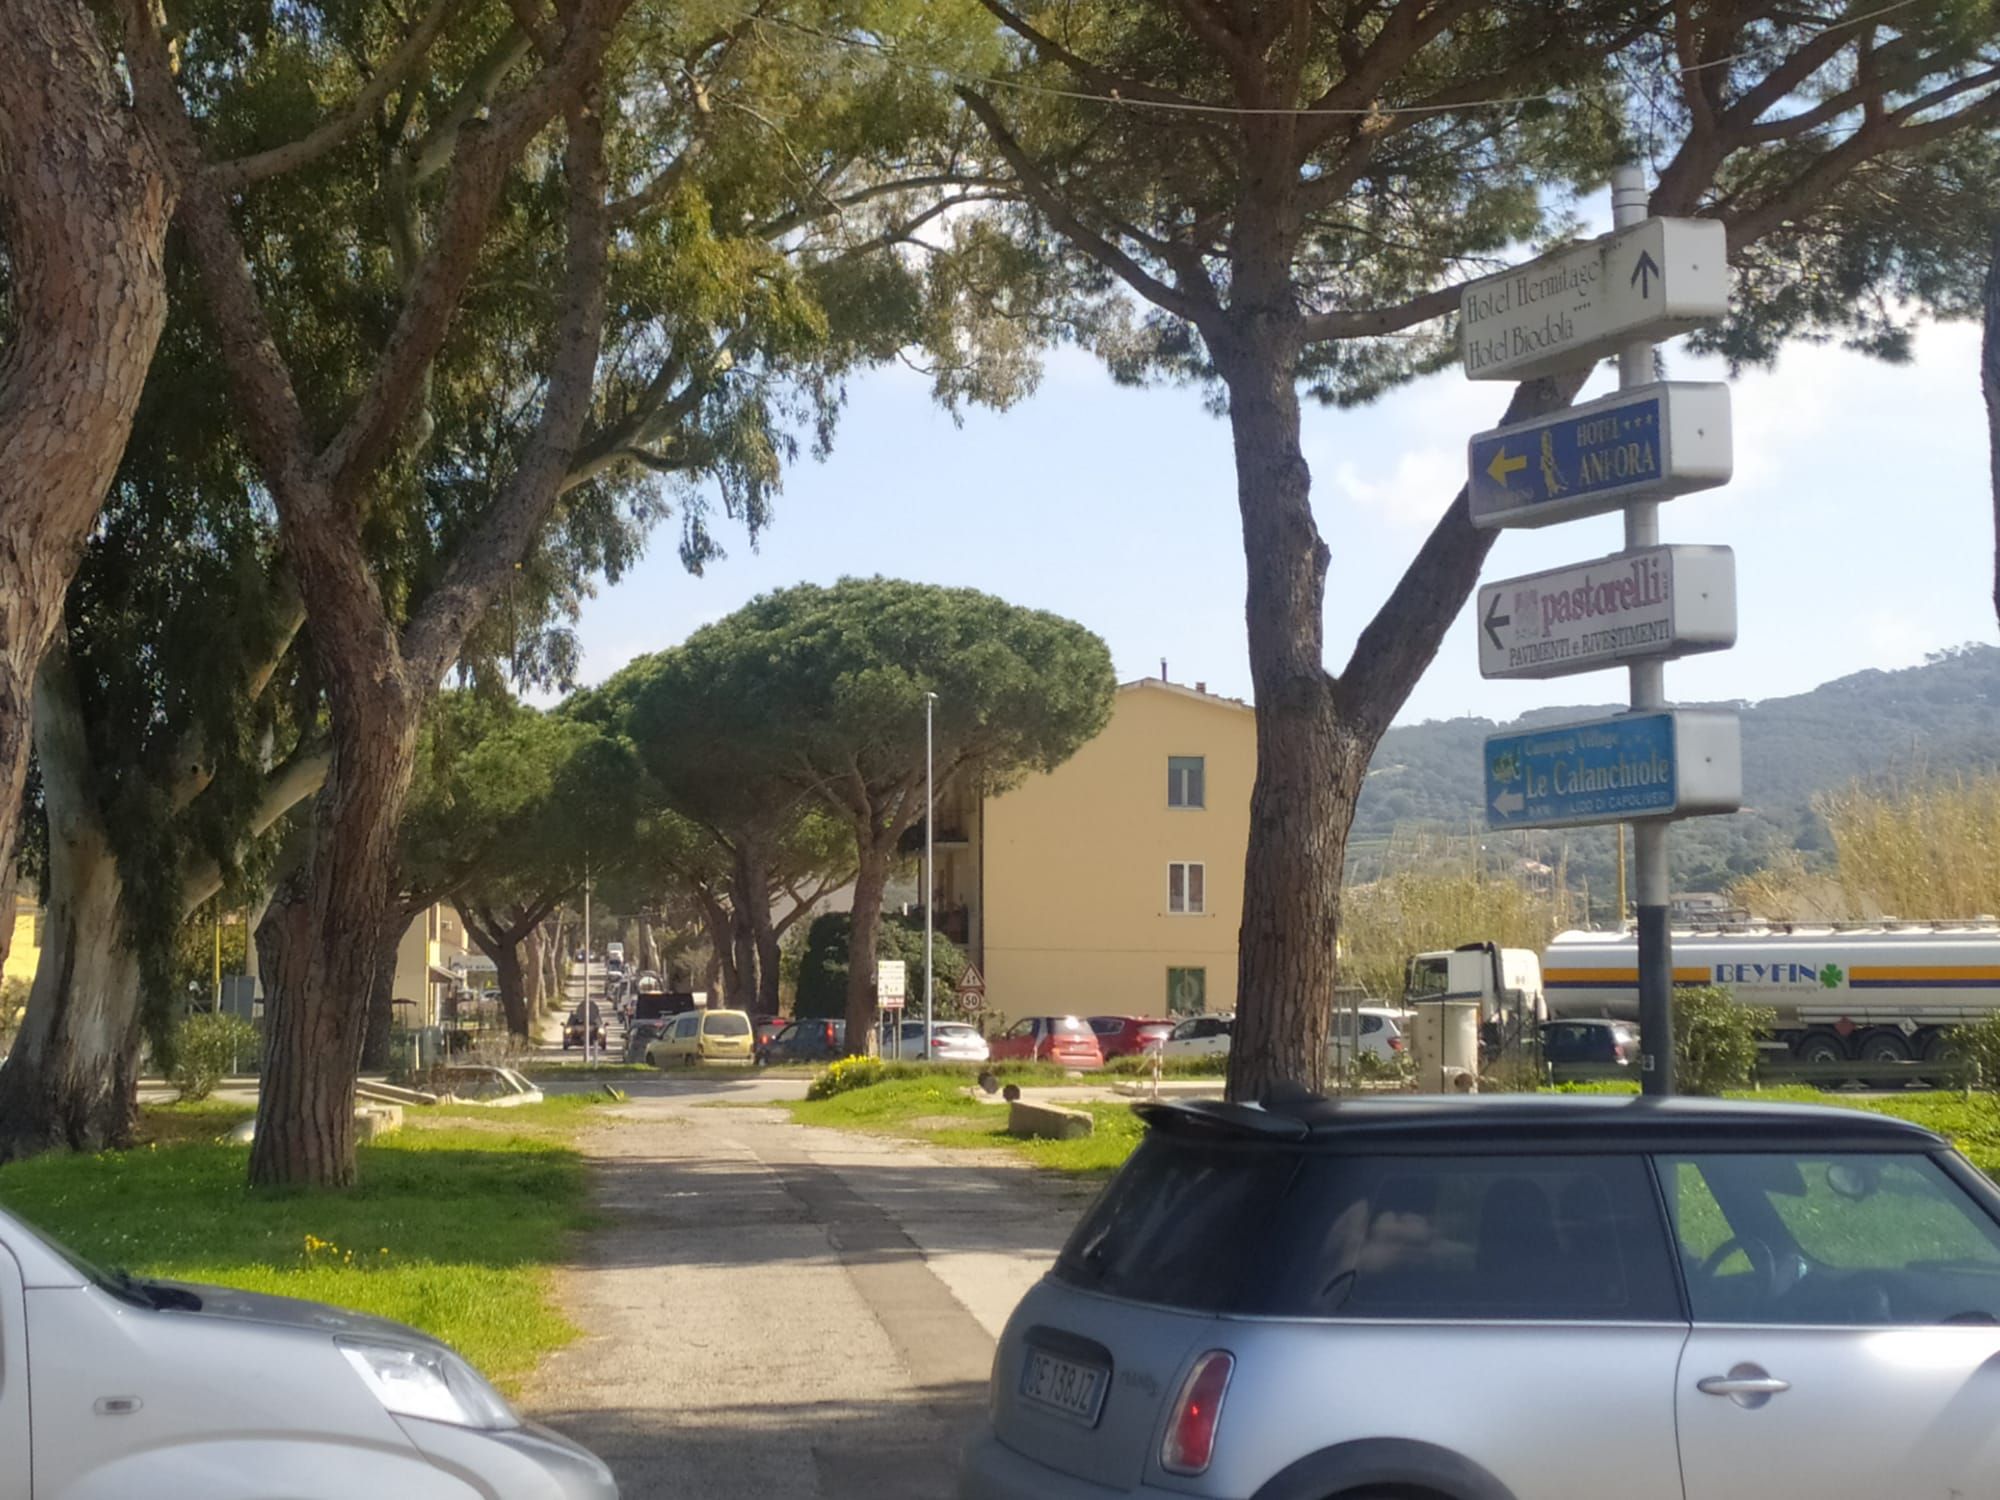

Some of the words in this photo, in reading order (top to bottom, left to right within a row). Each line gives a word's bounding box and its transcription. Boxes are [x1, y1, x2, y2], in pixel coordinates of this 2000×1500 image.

[1467, 285, 1510, 324] Hotel
[1517, 262, 1600, 306] Hermitage
[1468, 334, 1508, 370] Hotel
[1512, 312, 1574, 356] Biodola
[1576, 415, 1620, 447] HOTEL
[1579, 440, 1656, 486] ANFORA
[1542, 559, 1663, 637] pastorelli
[1509, 638, 1570, 667] PAVIMENTI
[1572, 640, 1581, 655] e
[1582, 619, 1670, 654] RIVESTIMENTI
[1526, 765, 1549, 799] Le
[1553, 751, 1669, 796] Calanchiole
[1716, 964, 1817, 982] BEYFIN
[965, 995, 977, 1006] 50
